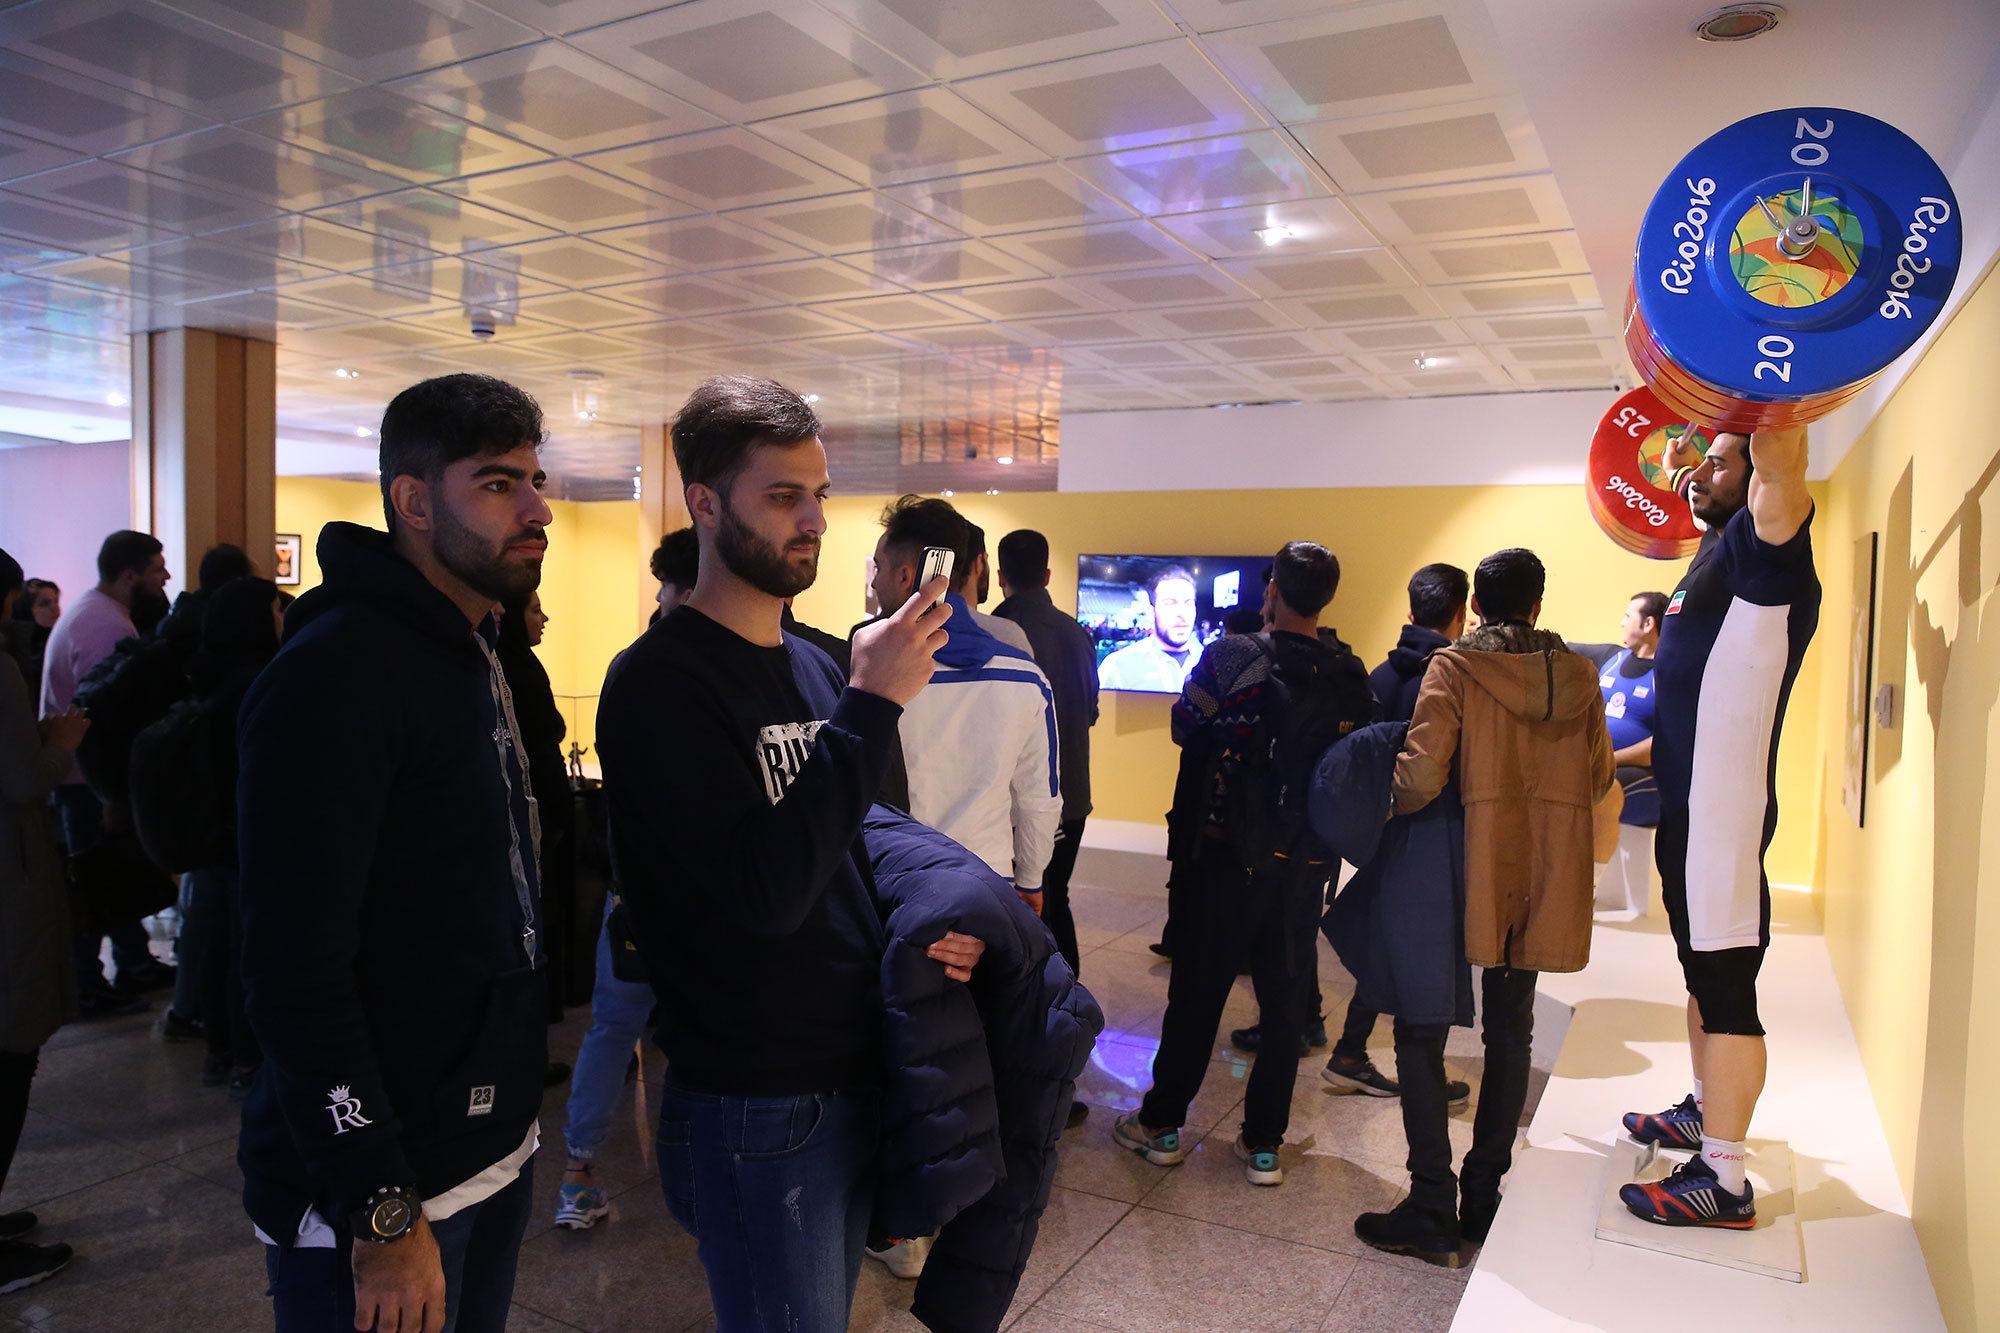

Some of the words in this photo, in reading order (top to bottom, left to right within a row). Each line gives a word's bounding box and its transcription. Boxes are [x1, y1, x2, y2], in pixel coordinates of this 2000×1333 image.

[1790, 117, 1834, 166] 20
[1660, 177, 1716, 294] Rio2016
[1879, 196, 1951, 320] Rio2016
[1754, 335, 1795, 383] 20
[1613, 406, 1651, 438] 25
[1605, 475, 1670, 527] Rio2016
[473, 1088, 492, 1106] 23
